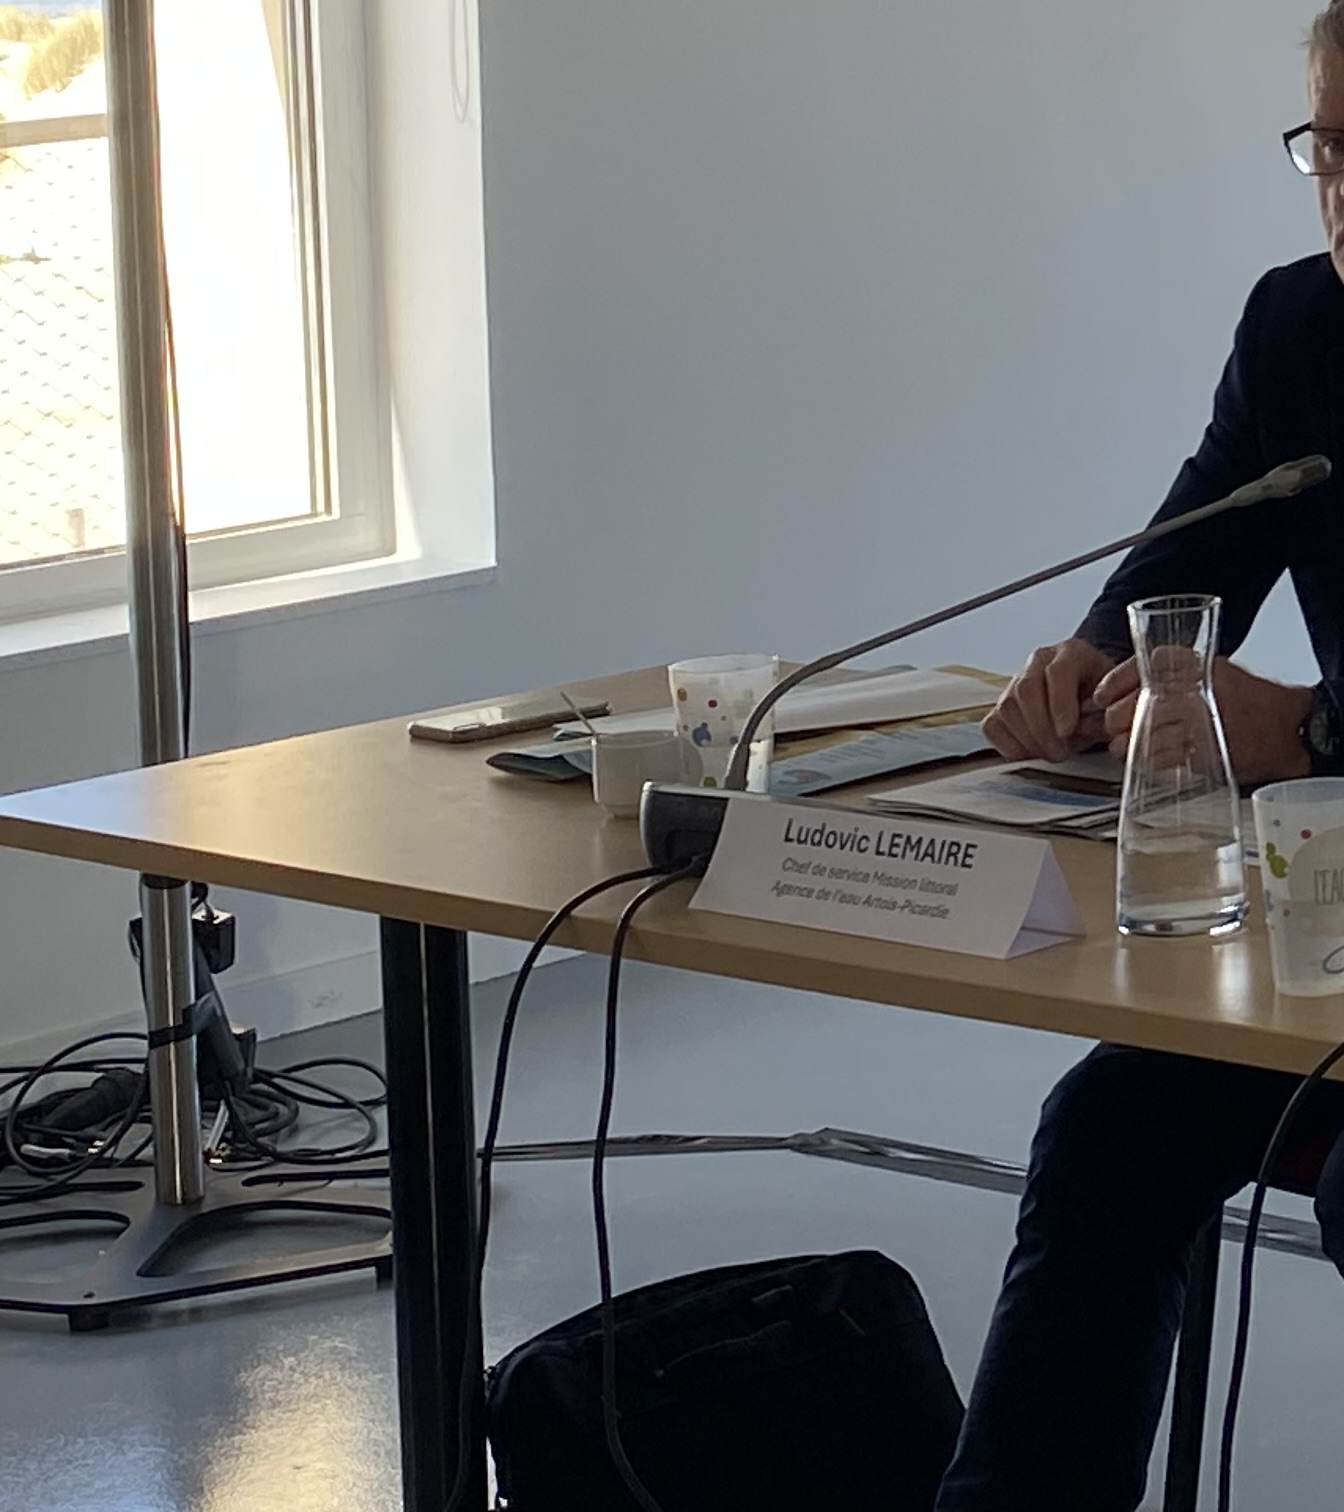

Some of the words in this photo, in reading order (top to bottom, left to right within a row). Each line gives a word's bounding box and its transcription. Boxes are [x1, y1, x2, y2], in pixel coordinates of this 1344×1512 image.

[784, 817, 871, 854] Ludovic
[874, 830, 979, 869] LEMAIRE
[782, 857, 812, 875] Chef
[811, 862, 827, 877] de
[827, 867, 871, 884] service
[872, 871, 918, 890] Mission
[771, 880, 815, 898] Agence
[815, 887, 832, 901] de
